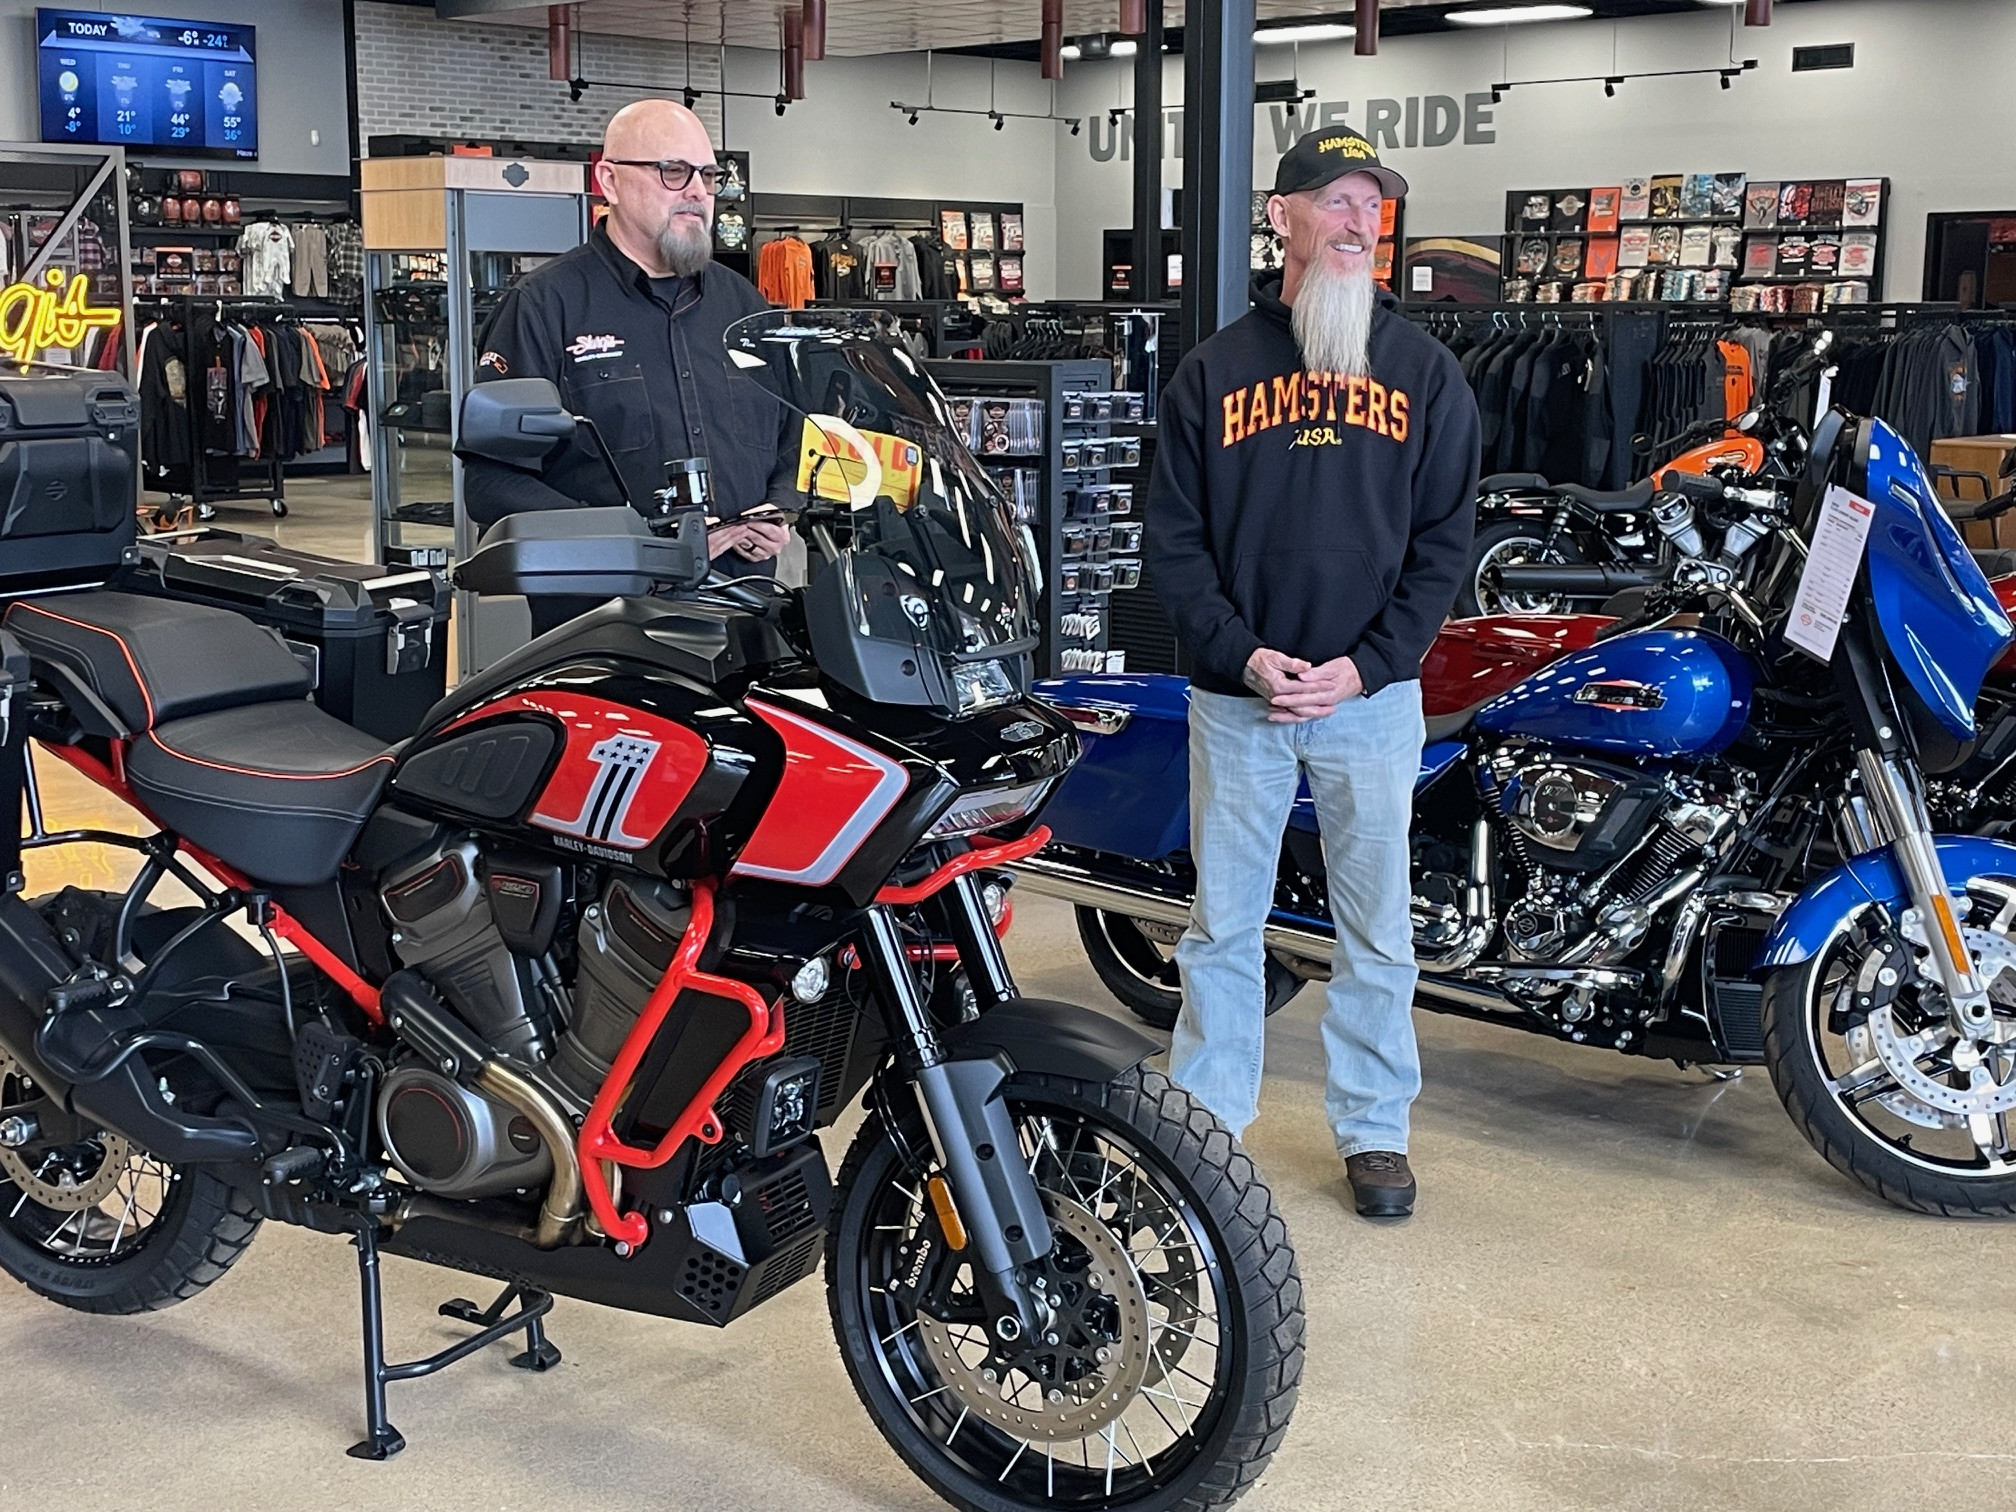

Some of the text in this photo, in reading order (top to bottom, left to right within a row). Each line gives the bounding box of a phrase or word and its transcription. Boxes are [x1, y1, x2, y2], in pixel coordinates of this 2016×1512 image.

[68, 22, 107, 36] TODAY
[1366, 92, 1496, 149] RIDE
[1318, 136, 1377, 158] HAMST
[1222, 370, 1410, 448] HAMSTERS
[553, 834, 633, 864] HARLEY-DAVIDSON
[904, 1239, 931, 1289] brembo
